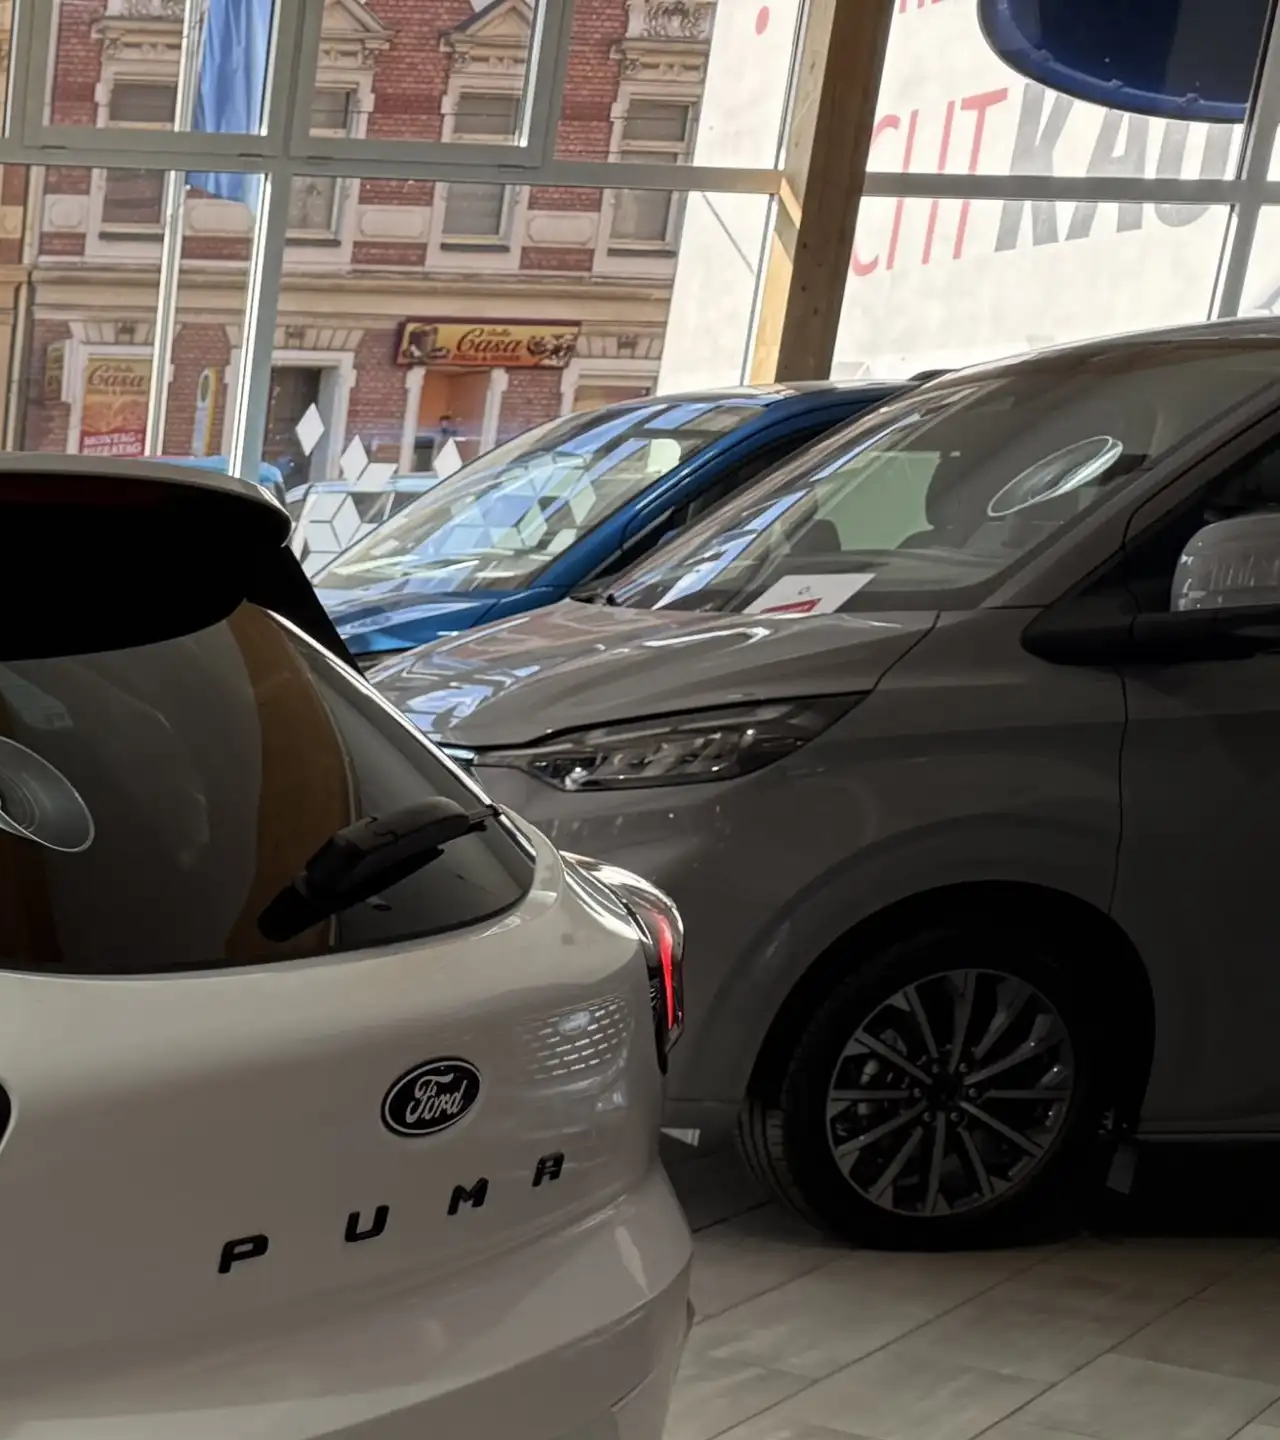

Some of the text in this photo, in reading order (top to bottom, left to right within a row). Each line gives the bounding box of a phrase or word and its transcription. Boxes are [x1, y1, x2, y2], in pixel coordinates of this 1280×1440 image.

[455, 327, 524, 354] Casa
[406, 1073, 469, 1124] Ford
[217, 1150, 566, 1275] PUMA
